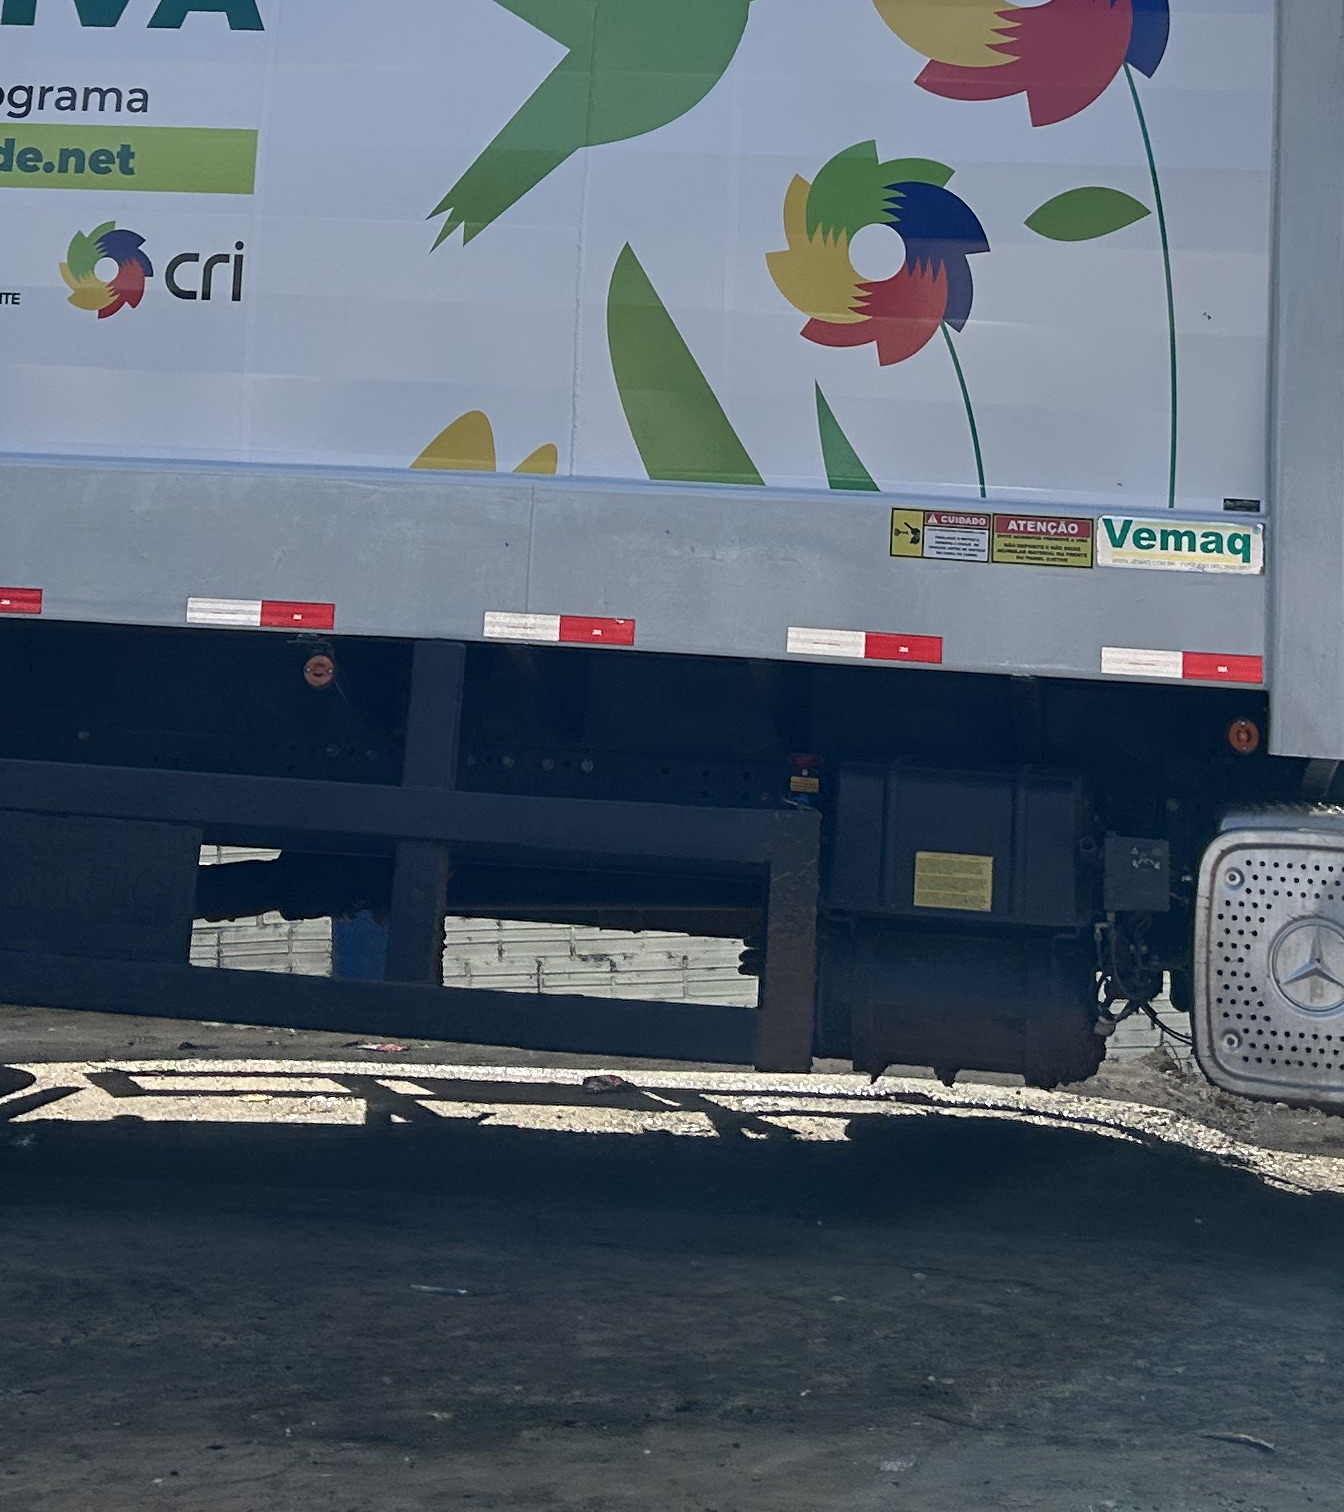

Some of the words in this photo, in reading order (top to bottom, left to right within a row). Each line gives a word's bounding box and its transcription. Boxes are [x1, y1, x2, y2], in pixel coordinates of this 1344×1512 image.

[164, 240, 245, 302] cri
[940, 515, 987, 526] CUIDADO
[1007, 519, 1079, 535] ATENÇÃO
[1102, 518, 1251, 564] Vemaq
